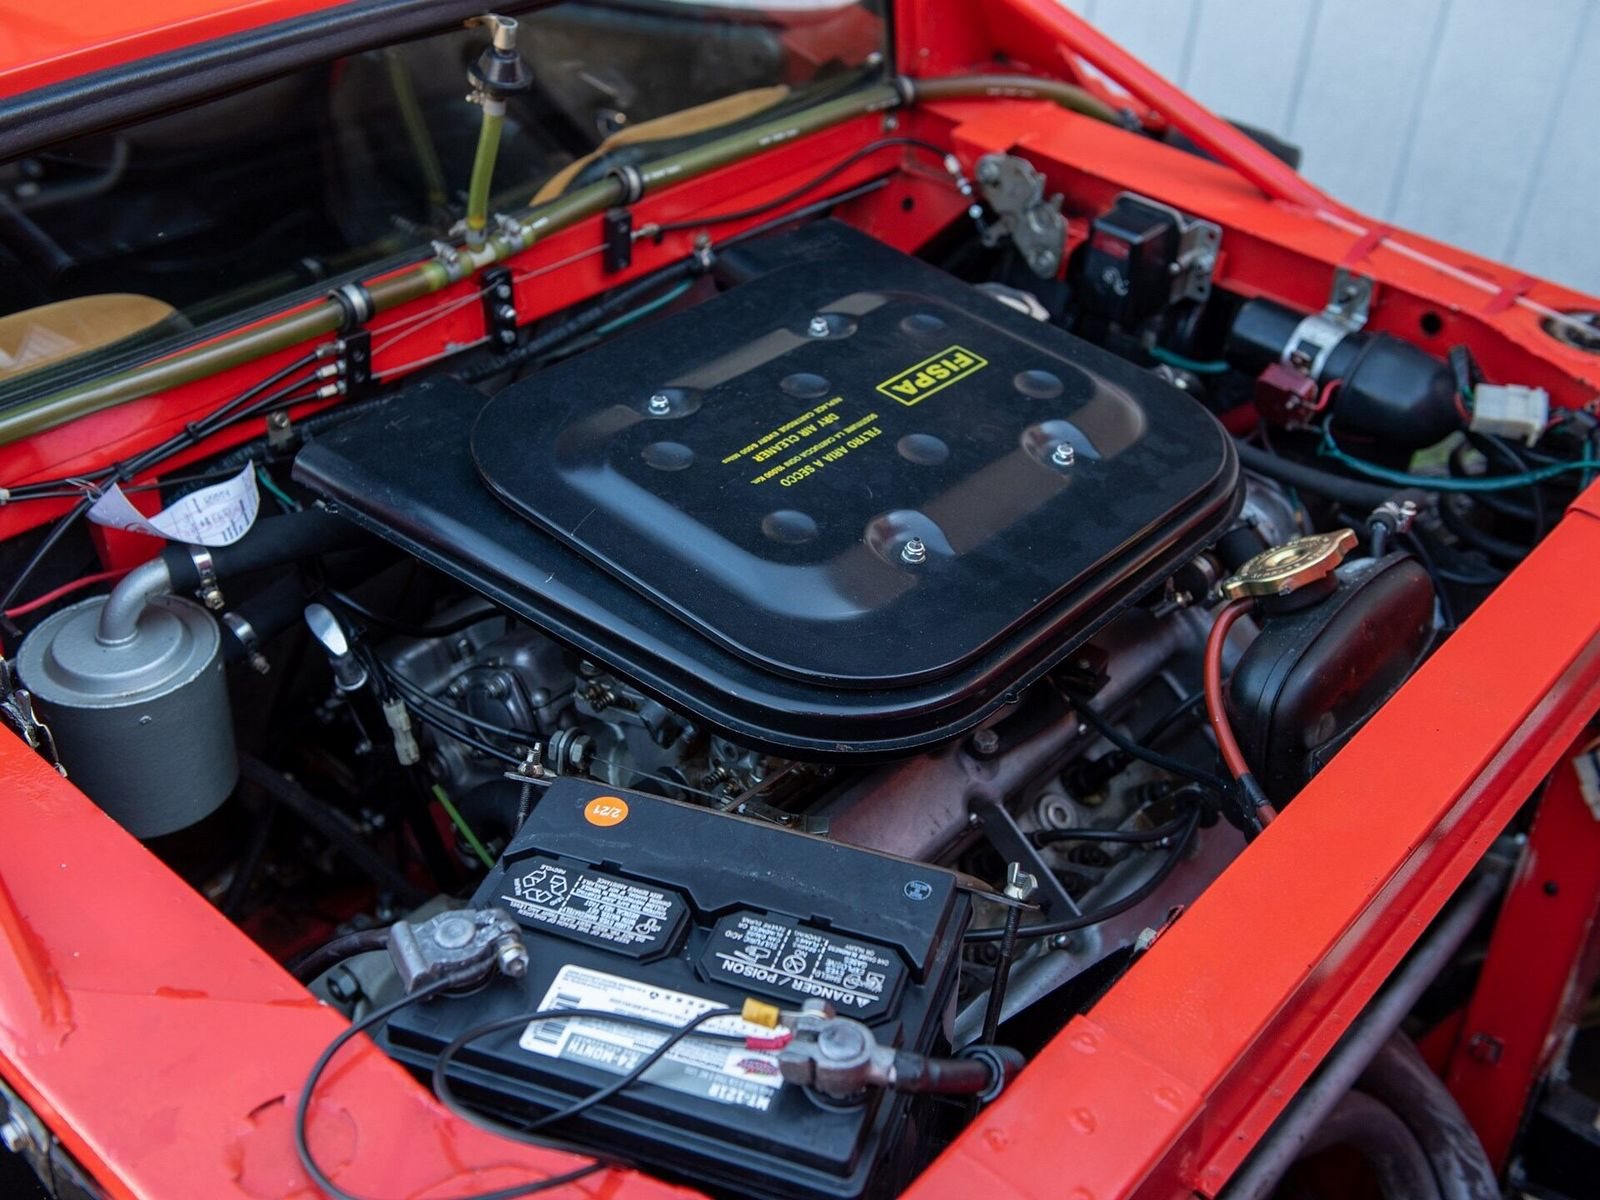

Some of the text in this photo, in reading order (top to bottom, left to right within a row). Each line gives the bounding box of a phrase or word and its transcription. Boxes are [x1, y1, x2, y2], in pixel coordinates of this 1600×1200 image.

[891, 352, 974, 394] FISPA
[812, 395, 843, 414] REPLACE
[777, 410, 815, 433] CARTRIDGE
[751, 412, 840, 463] DRY AIR CLEANER
[756, 430, 780, 445] EVERY
[832, 431, 845, 439] LA
[798, 435, 836, 458] CARTUCCIA
[778, 426, 882, 487] FILTRO ARIA A SECCO
[593, 804, 621, 818] 2/21
[541, 864, 566, 873] RECYCLE
[516, 908, 547, 921] CHILDREN
[736, 921, 748, 929] OR
[723, 929, 778, 949] SULFURIC ACID
[793, 949, 808, 957] NO
[722, 960, 855, 1003] DANGER / POISON
[815, 970, 840, 983] SHIELD
[567, 1042, 636, 1068] 24-MONTH
